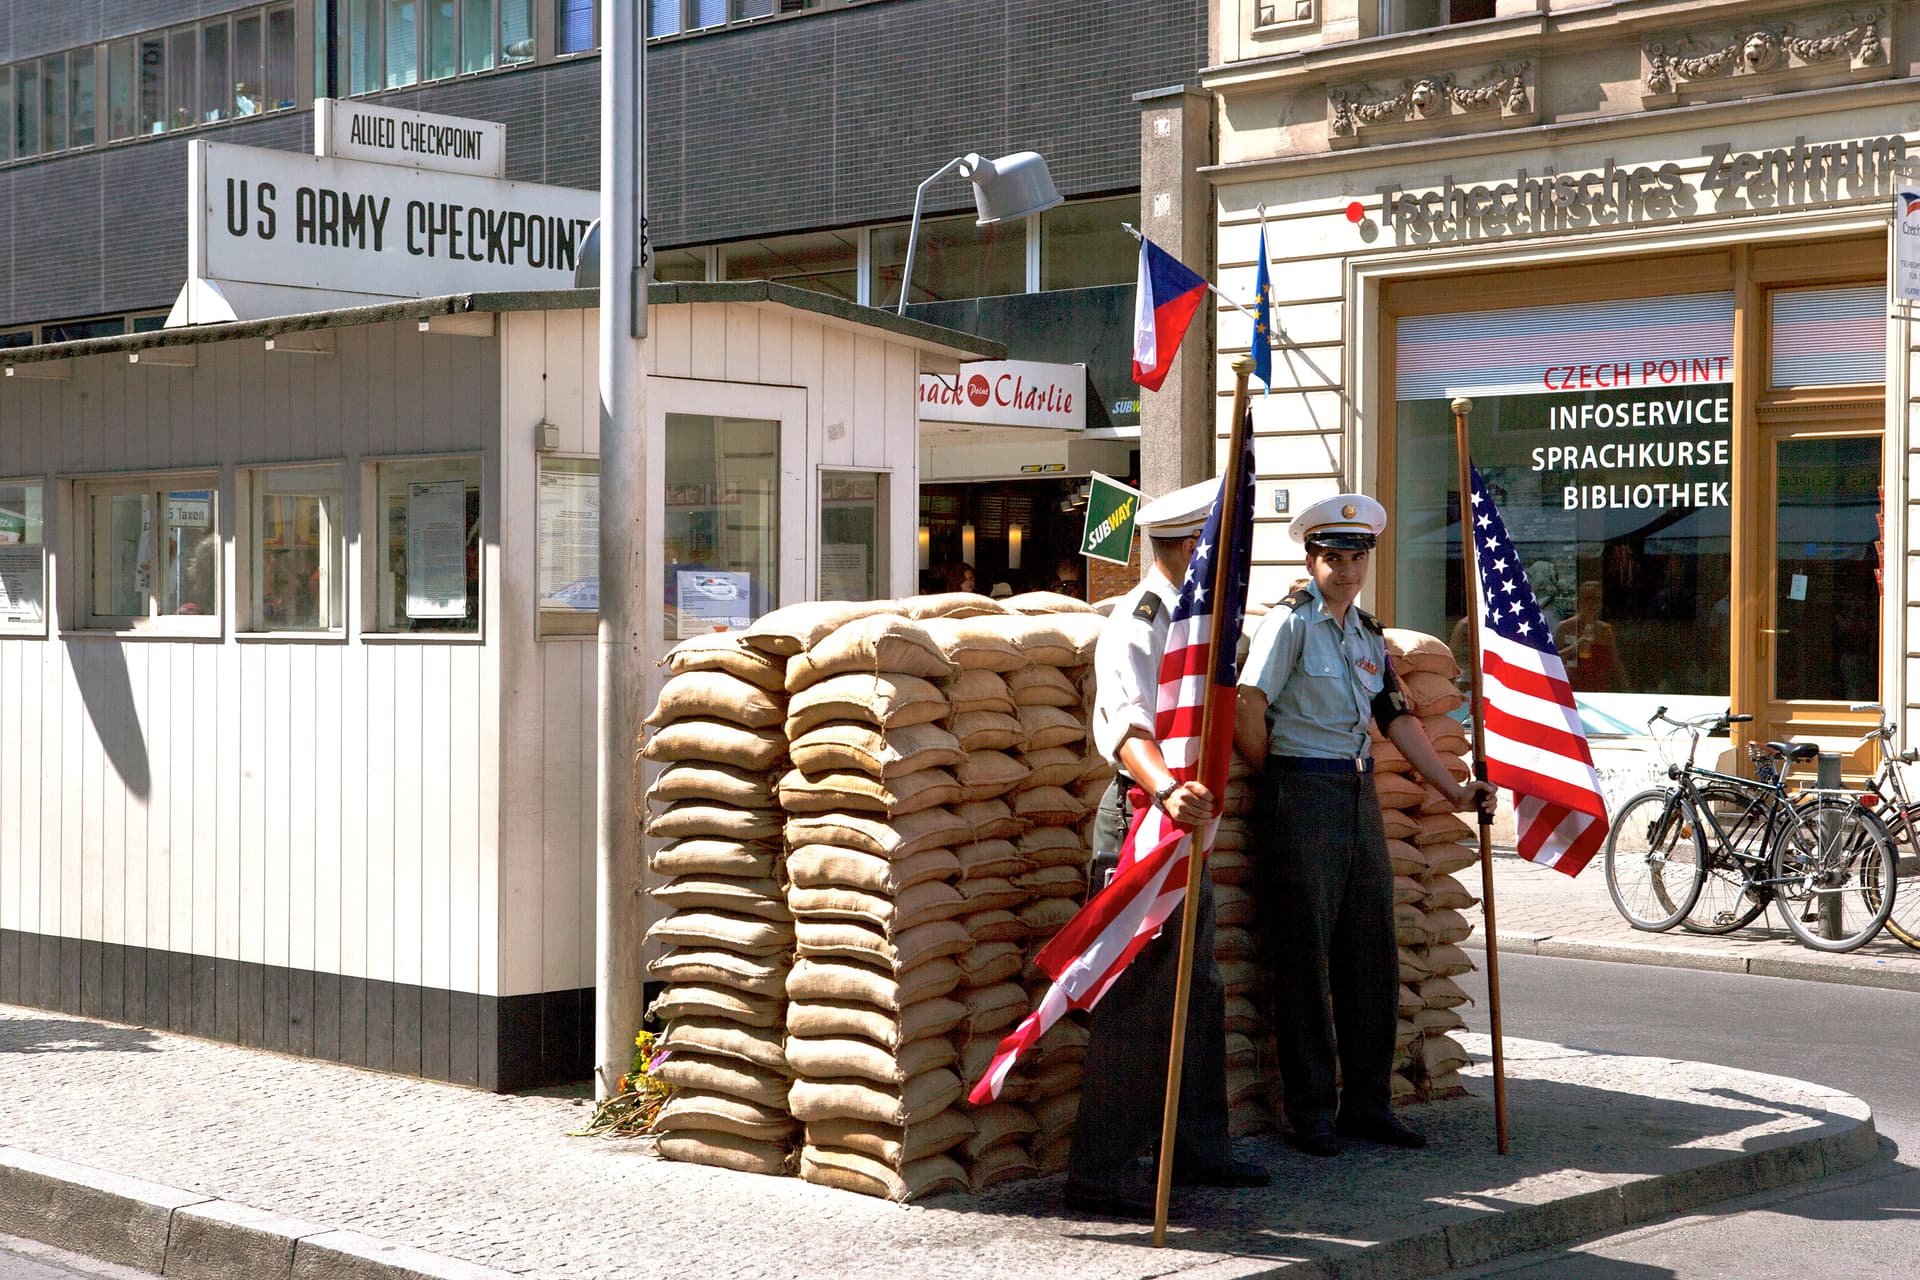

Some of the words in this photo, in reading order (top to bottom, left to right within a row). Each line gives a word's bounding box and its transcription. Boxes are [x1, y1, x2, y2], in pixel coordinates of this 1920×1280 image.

[350, 113, 395, 149] ALLIED
[401, 122, 484, 161] CHECKPOINT
[1375, 156, 1683, 227] Tschechisches
[1700, 134, 1906, 191] Zentrum
[226, 178, 276, 240] US
[296, 187, 390, 252] ARMY
[1543, 362, 1630, 391] CZECH
[1643, 356, 1729, 385] POINT
[994, 374, 1073, 413] Charlie
[1550, 398, 1729, 430] INFOSERVICE
[1531, 440, 1729, 471] SPRACHKURSE
[177, 507, 205, 521] Taxen
[1563, 482, 1729, 510] BIBLIOTHEK
[1087, 496, 1134, 551] SUBWAY
